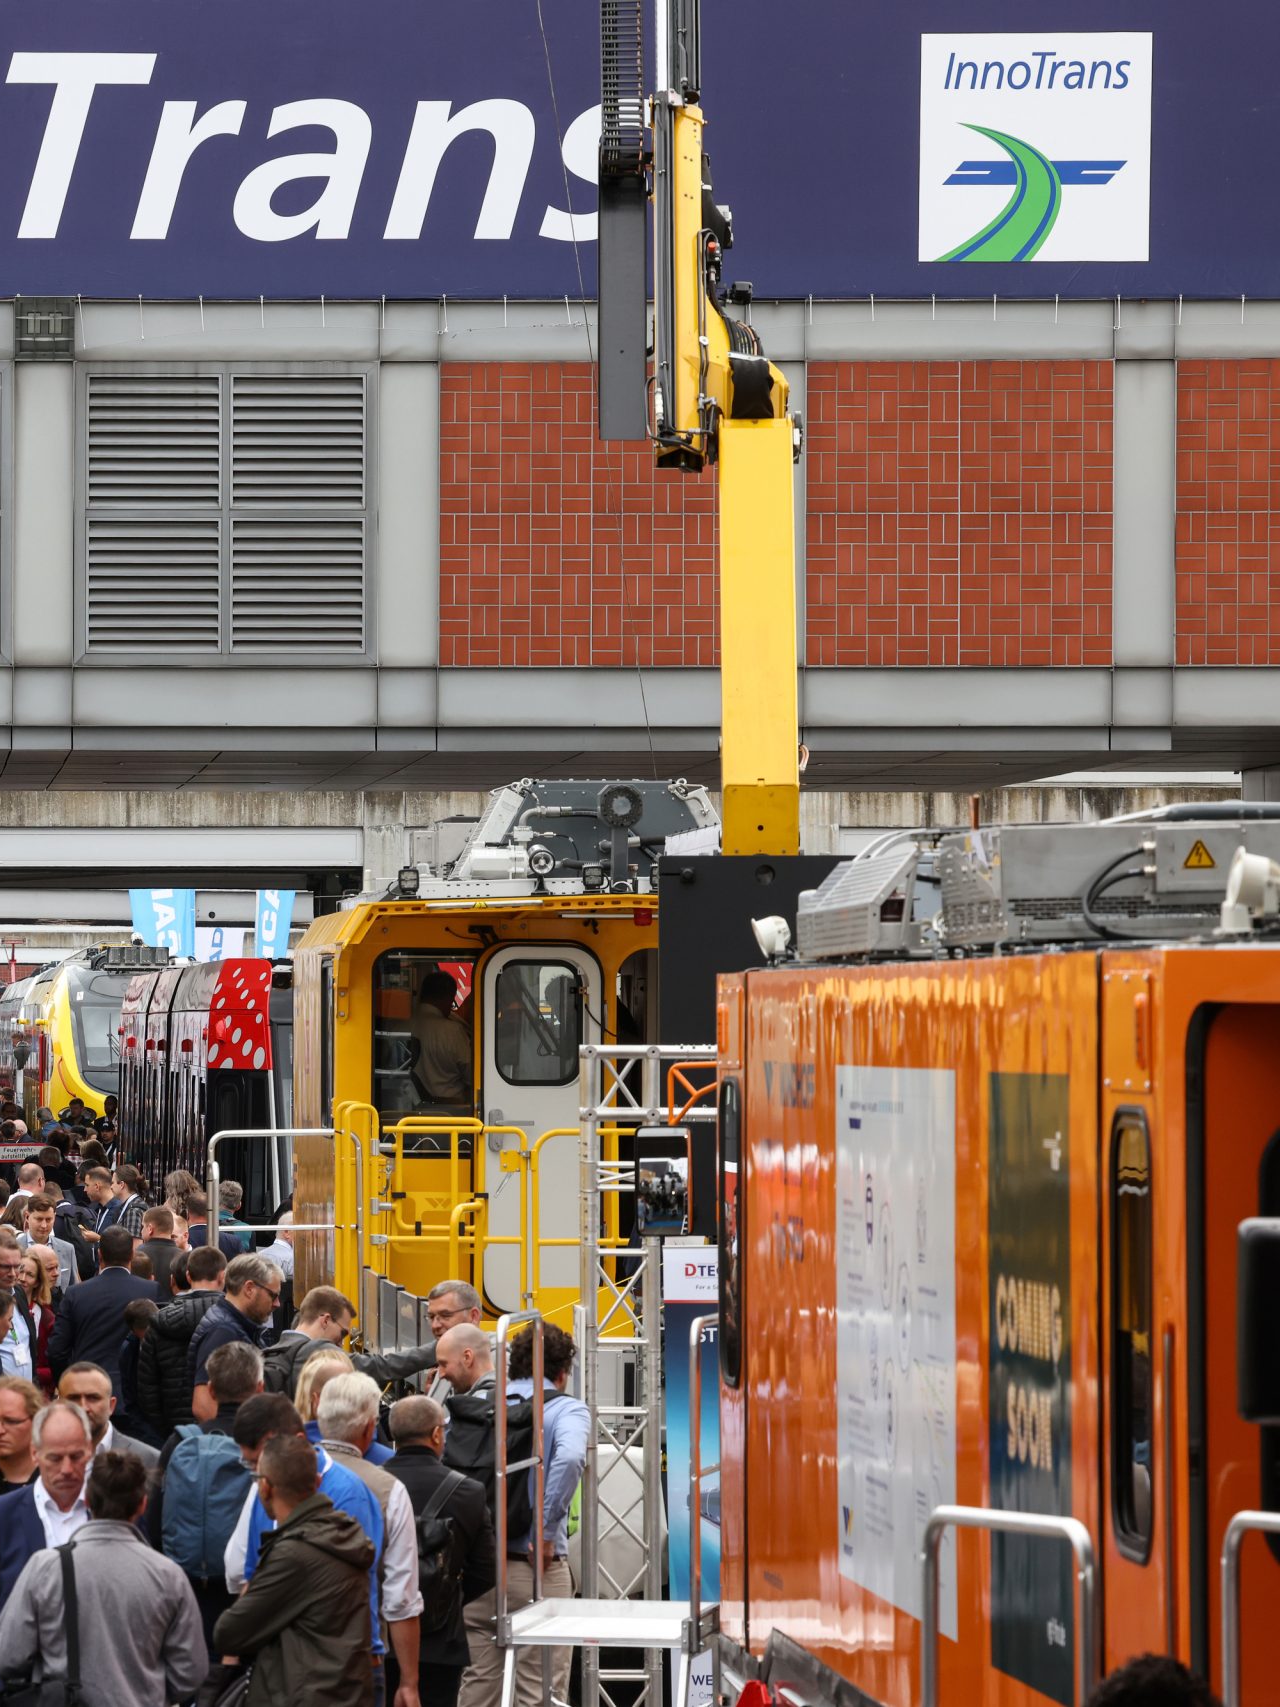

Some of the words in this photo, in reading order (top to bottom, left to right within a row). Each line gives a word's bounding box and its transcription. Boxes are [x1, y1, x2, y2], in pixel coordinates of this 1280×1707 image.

[943, 51, 1132, 90] InnoTrans
[995, 1272, 1062, 1363] COMING
[1006, 1380, 1052, 1472] SOON
